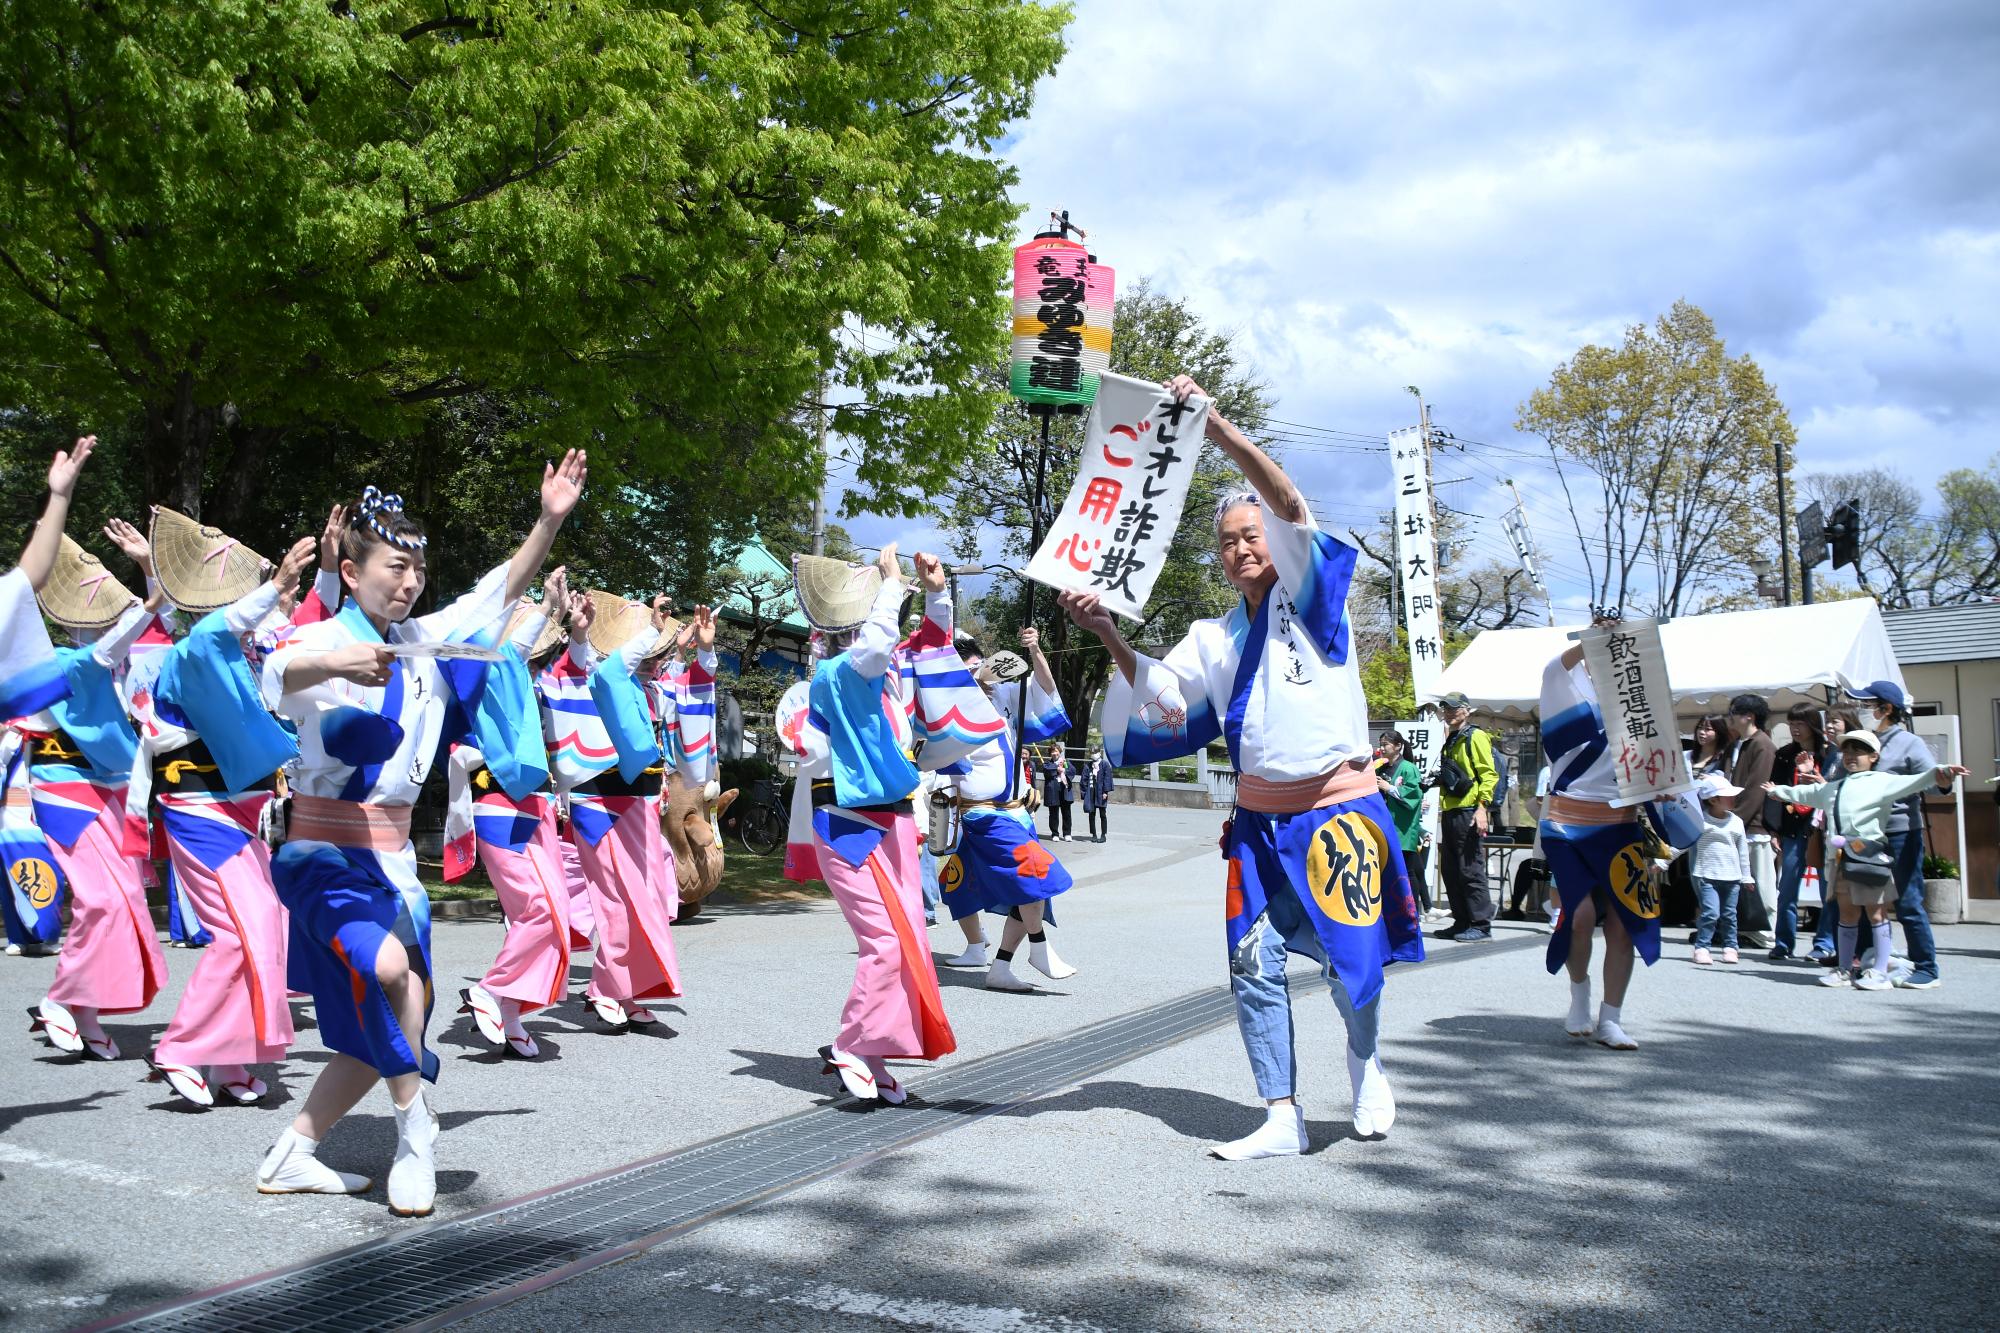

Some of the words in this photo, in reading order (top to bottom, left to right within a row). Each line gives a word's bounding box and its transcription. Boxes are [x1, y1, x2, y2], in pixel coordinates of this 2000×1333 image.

[1054, 420, 1151, 572] ご用心
[1091, 398, 1196, 602] オレオレ詐欺
[1605, 632, 1659, 741] 飲酒運転
